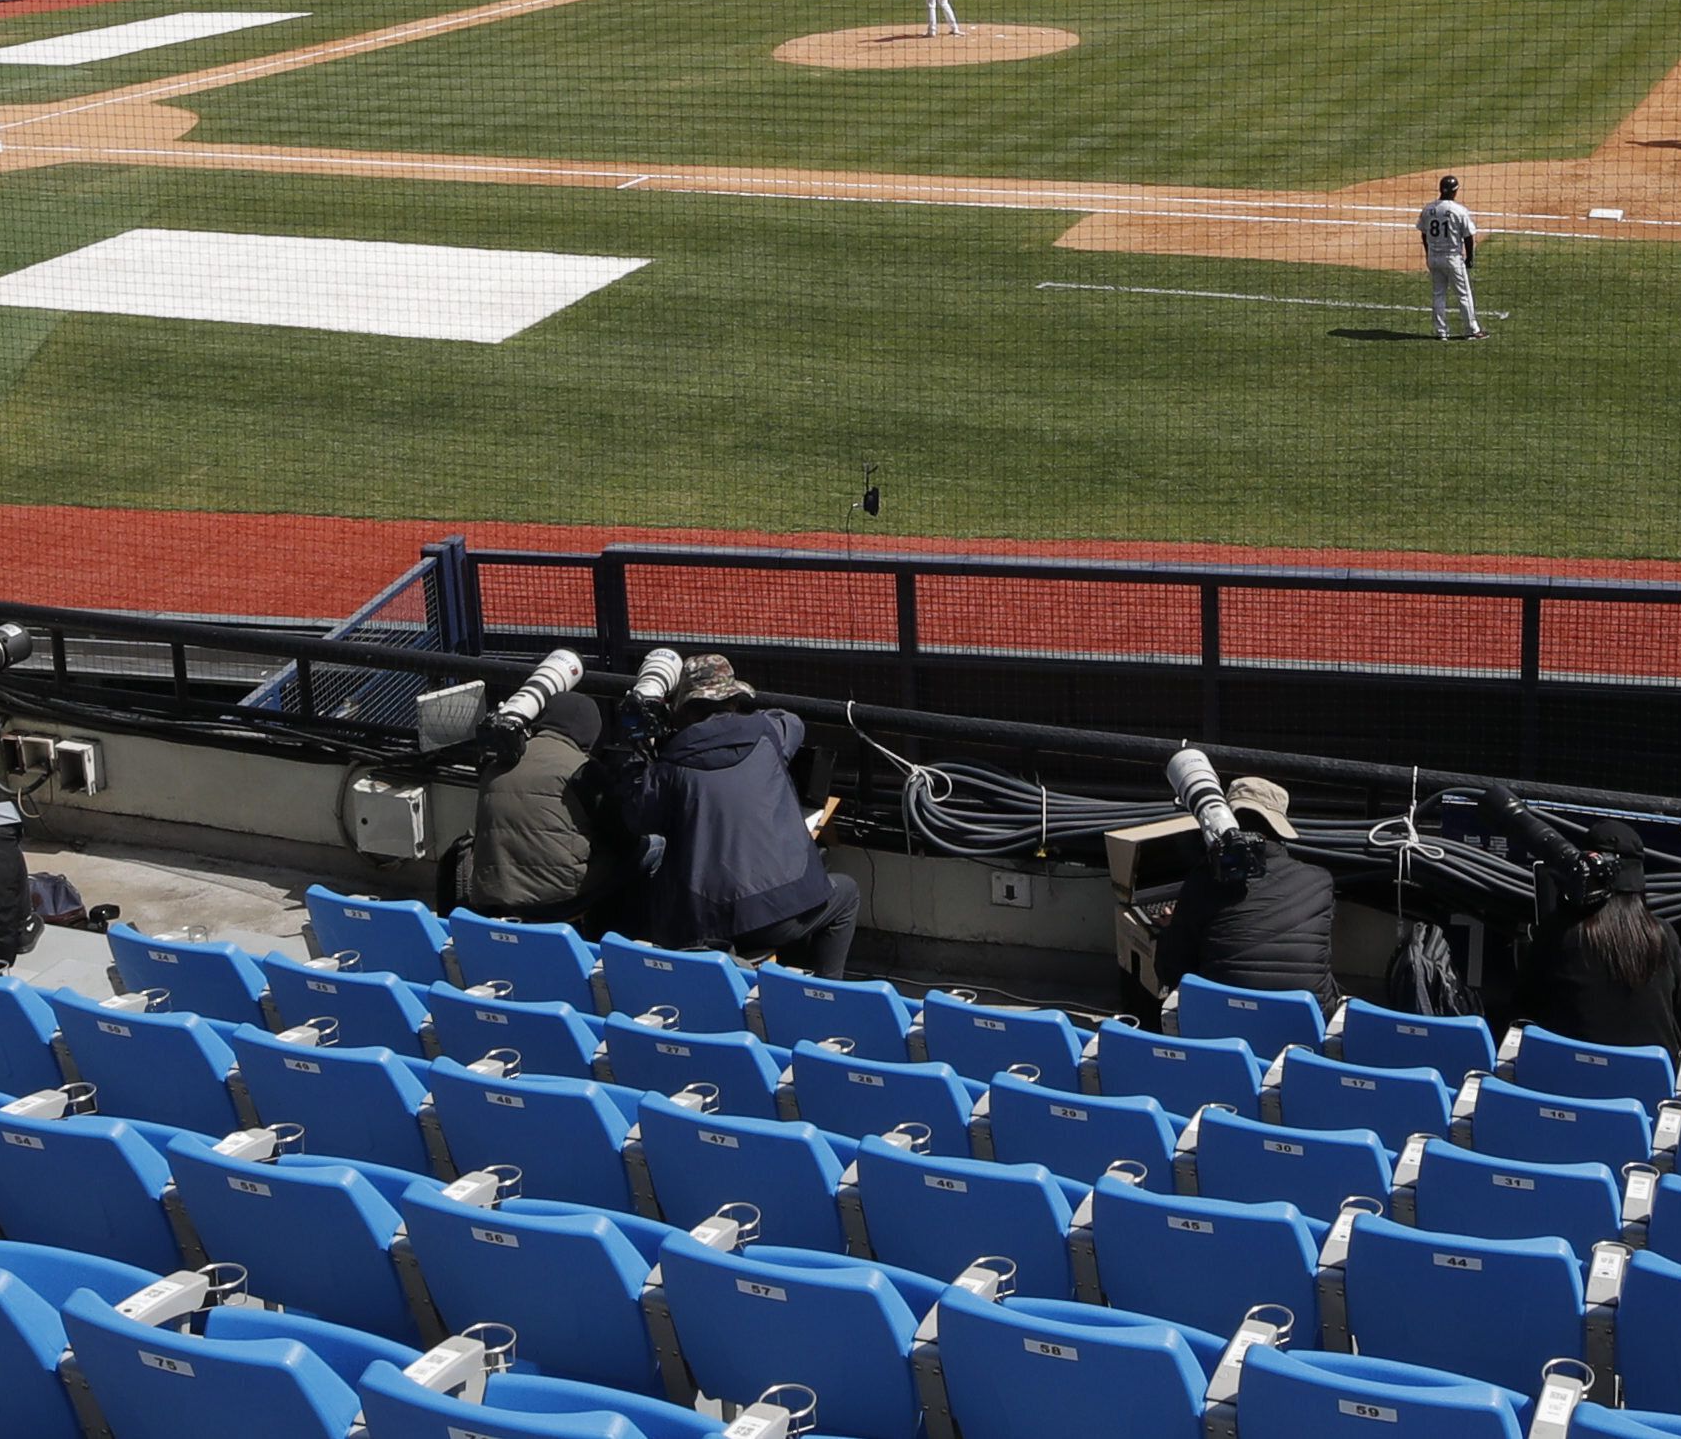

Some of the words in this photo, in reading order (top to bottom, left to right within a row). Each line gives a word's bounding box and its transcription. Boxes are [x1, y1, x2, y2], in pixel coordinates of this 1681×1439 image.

[1429, 220, 1448, 238] 81
[294, 1061, 309, 1071] 49
[15, 1136, 31, 1145] 54
[241, 1182, 257, 1192] 55
[1180, 1221, 1200, 1230] 45
[485, 1233, 504, 1243] 56
[1447, 1258, 1468, 1269] 44
[751, 1285, 770, 1295] 57
[1039, 1344, 1062, 1356] 58
[155, 1357, 177, 1370] 75
[1357, 1406, 1379, 1417] 59
